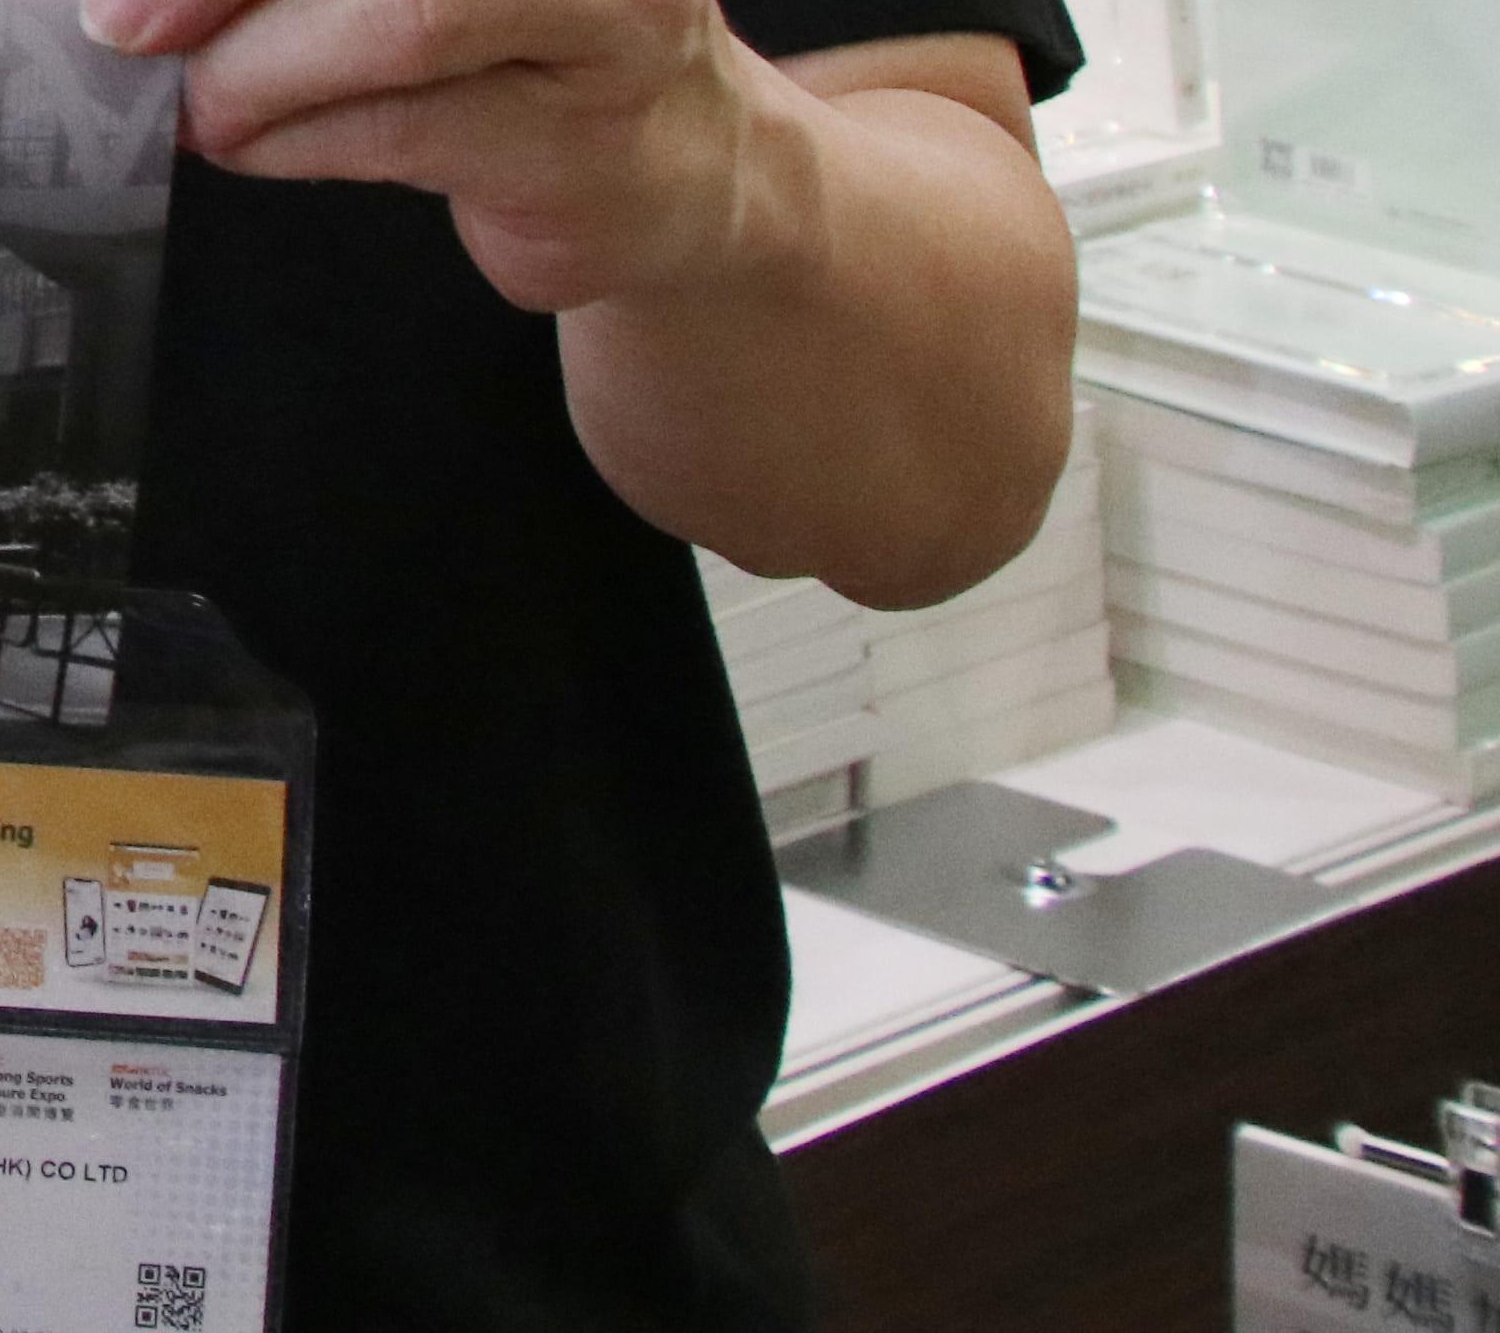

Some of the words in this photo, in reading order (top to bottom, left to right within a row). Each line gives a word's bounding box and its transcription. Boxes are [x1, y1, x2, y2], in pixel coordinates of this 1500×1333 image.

[26, 1071, 74, 1088] Sports
[109, 1077, 153, 1092] World
[155, 1080, 172, 1092] of
[174, 1081, 229, 1097] Snacks
[29, 1088, 66, 1103] Expo
[40, 1160, 76, 1181] CO
[83, 1163, 129, 1185] LTD
[1302, 1233, 1500, 1333] 媽媽
